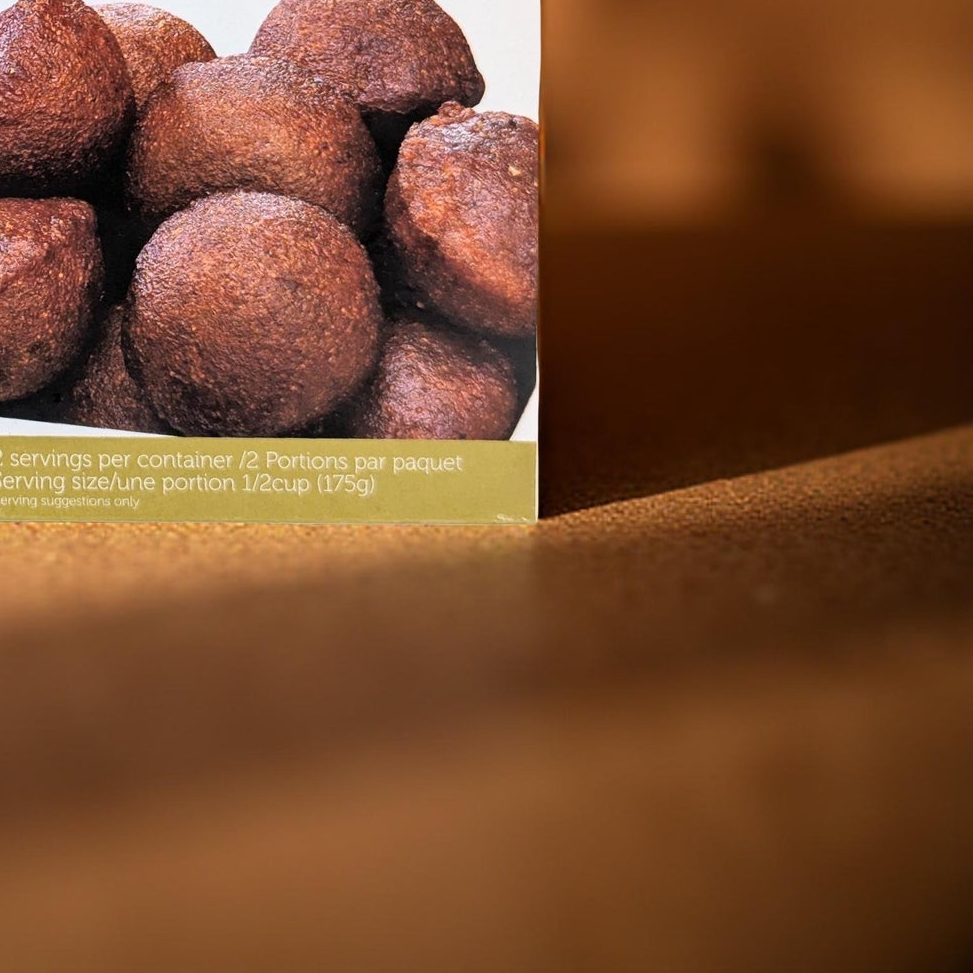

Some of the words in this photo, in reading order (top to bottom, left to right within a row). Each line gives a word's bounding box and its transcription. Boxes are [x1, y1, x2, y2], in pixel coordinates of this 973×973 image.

[10, 449, 92, 472] servings
[98, 453, 131, 471] per
[137, 451, 233, 469] container
[238, 450, 259, 470] /2
[266, 451, 348, 470] Portions
[354, 455, 386, 474] par
[392, 454, 463, 475] paquet
[72, 472, 156, 491] size/une
[162, 474, 236, 495] portion
[242, 473, 310, 495] 1/2cup
[316, 473, 375, 497] (175g)
[40, 494, 111, 509] suggestions
[113, 496, 140, 510] only
